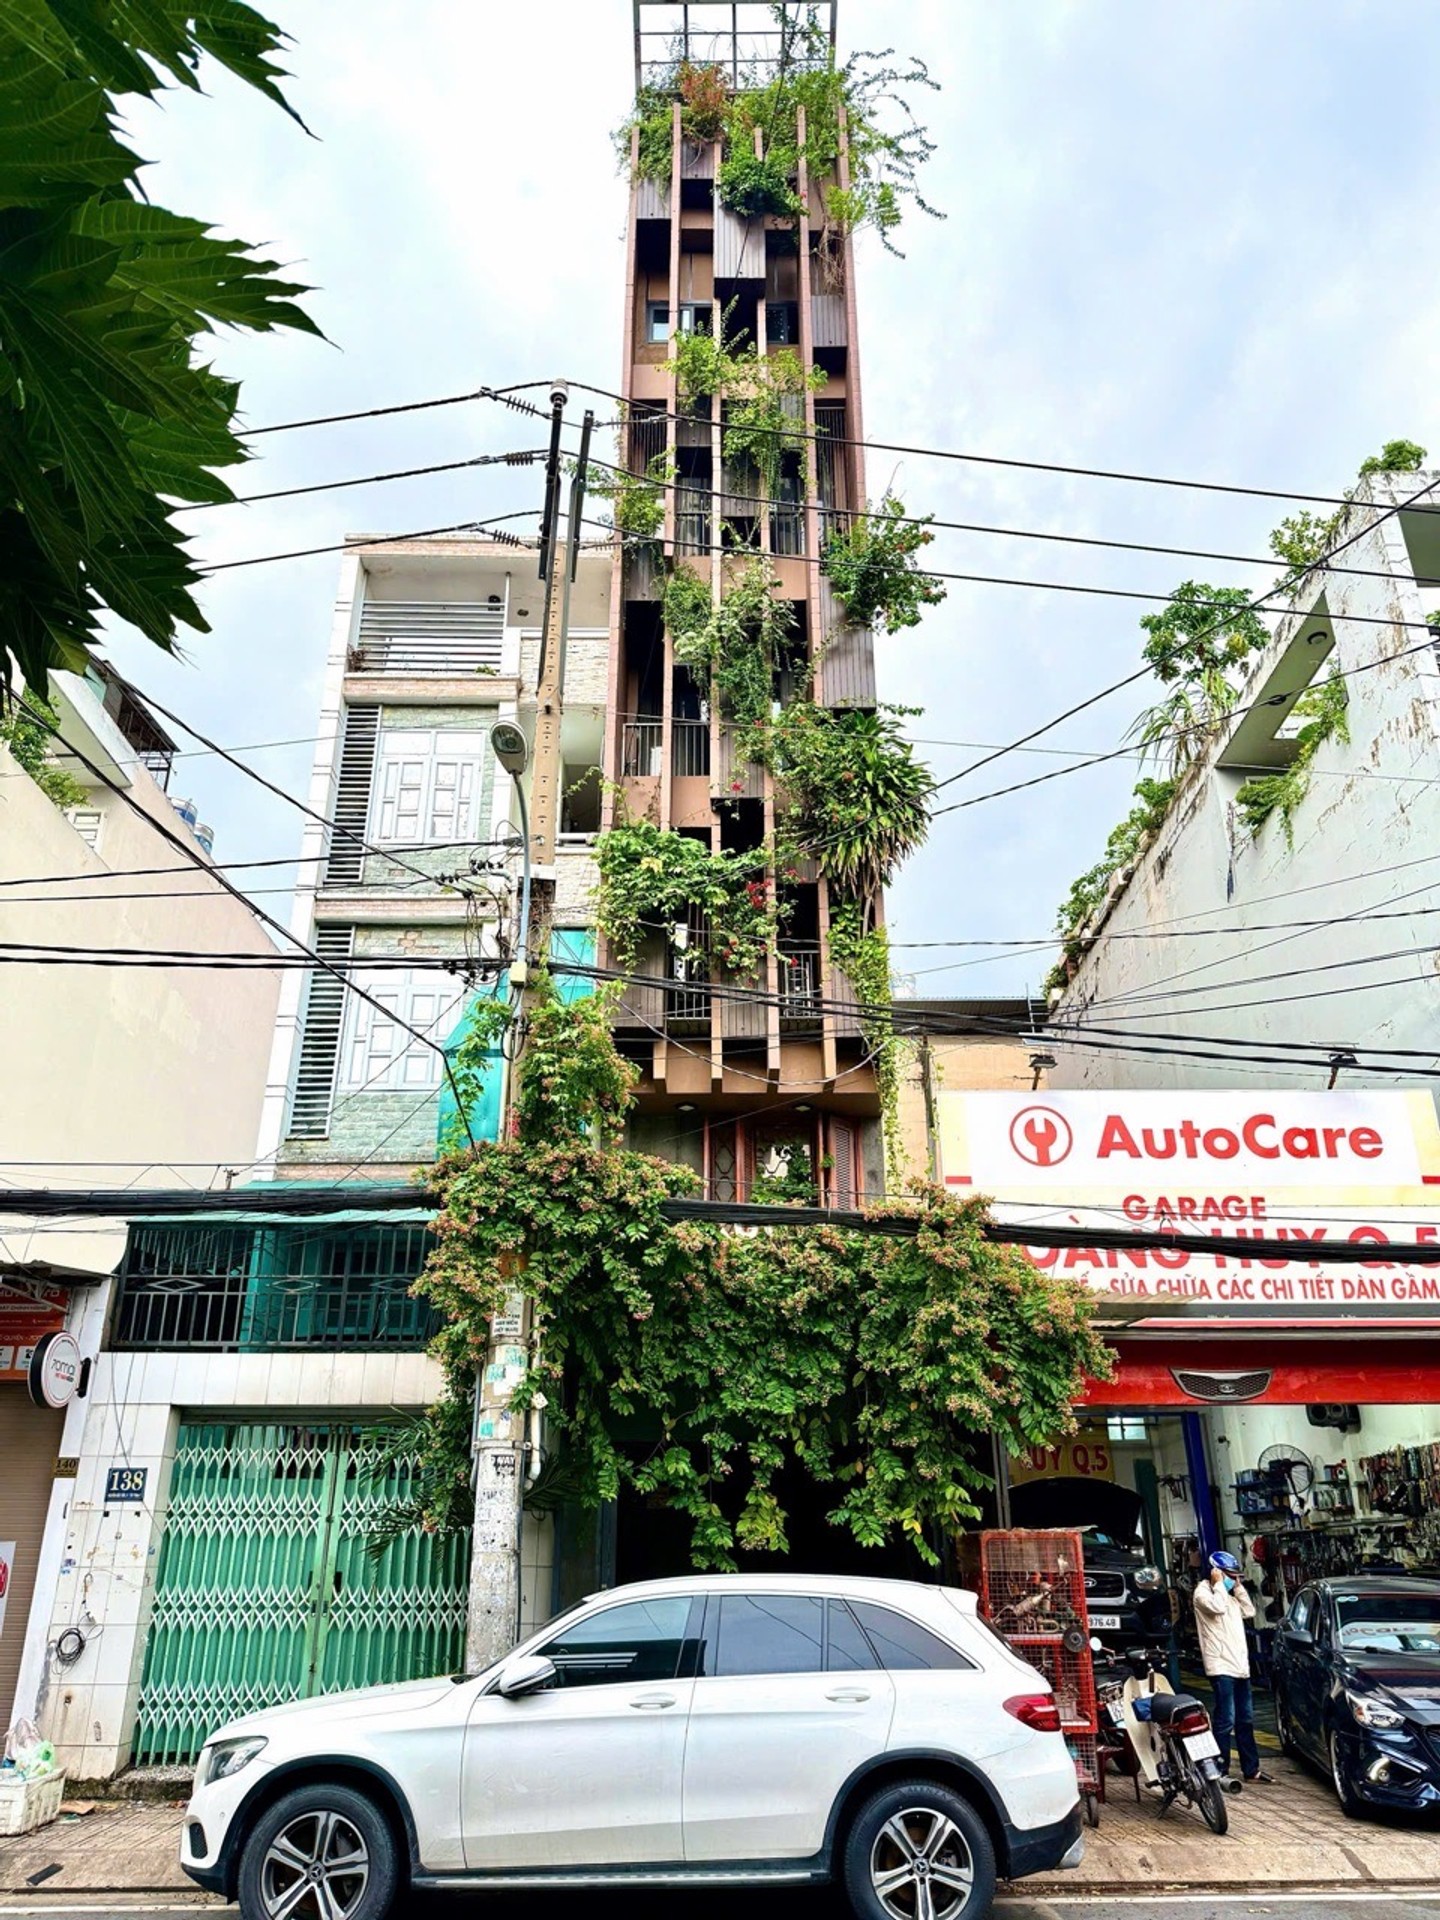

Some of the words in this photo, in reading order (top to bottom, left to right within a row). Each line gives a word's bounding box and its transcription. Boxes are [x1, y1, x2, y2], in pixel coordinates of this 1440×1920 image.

[1096, 1113, 1384, 1160] AutoCare
[1121, 1194, 1268, 1221] GARAGE
[1217, 1273, 1255, 1300] CÁC
[1261, 1278, 1294, 1300] CHI
[1298, 1270, 1335, 1300] TIẾT
[1341, 1274, 1387, 1300] DÀN
[1391, 1271, 1440, 1300] GẦM
[109, 1470, 144, 1491] 138
